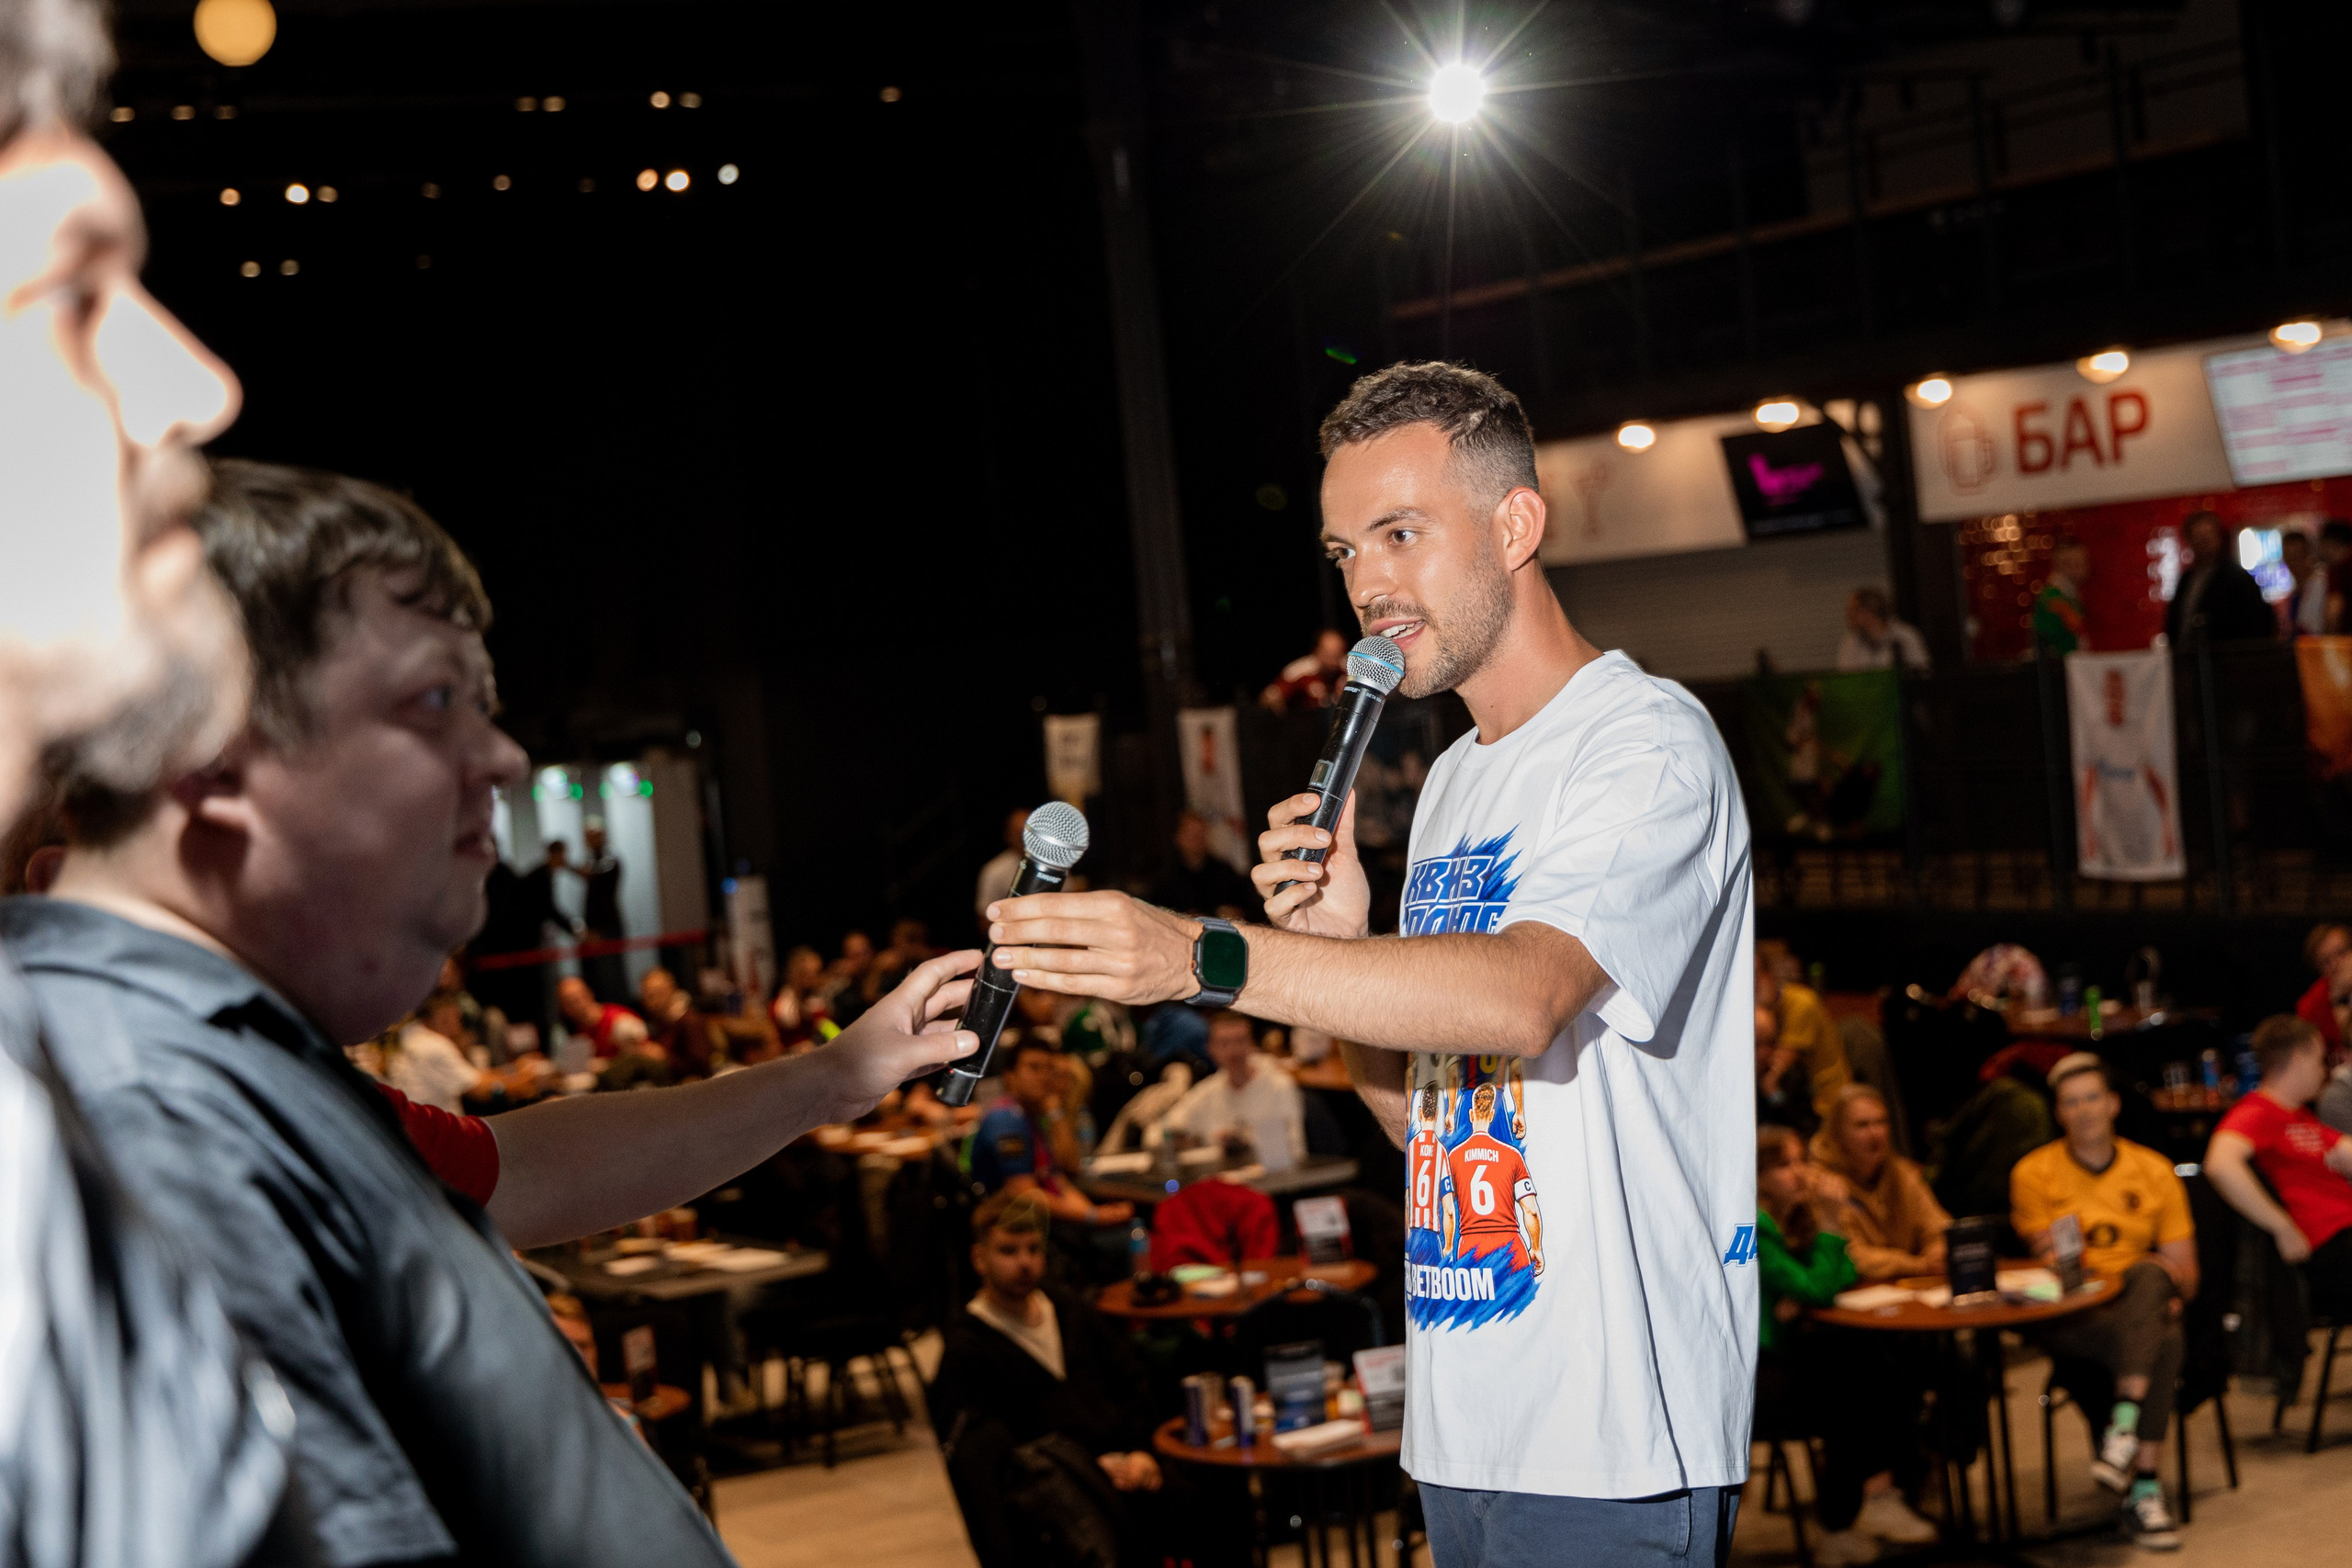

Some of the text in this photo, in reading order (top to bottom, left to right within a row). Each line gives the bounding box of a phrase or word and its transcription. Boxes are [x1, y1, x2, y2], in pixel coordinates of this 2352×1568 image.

[2013, 390, 2148, 475] БАР
[1036, 872, 1060, 884] SHURE
[1464, 1147, 1499, 1163] KIMMICH
[1416, 1159, 1430, 1207] 6
[1470, 1164, 1496, 1216] 6
[1523, 1180, 1532, 1192] C
[1411, 1263, 1496, 1302] BETBOOM
